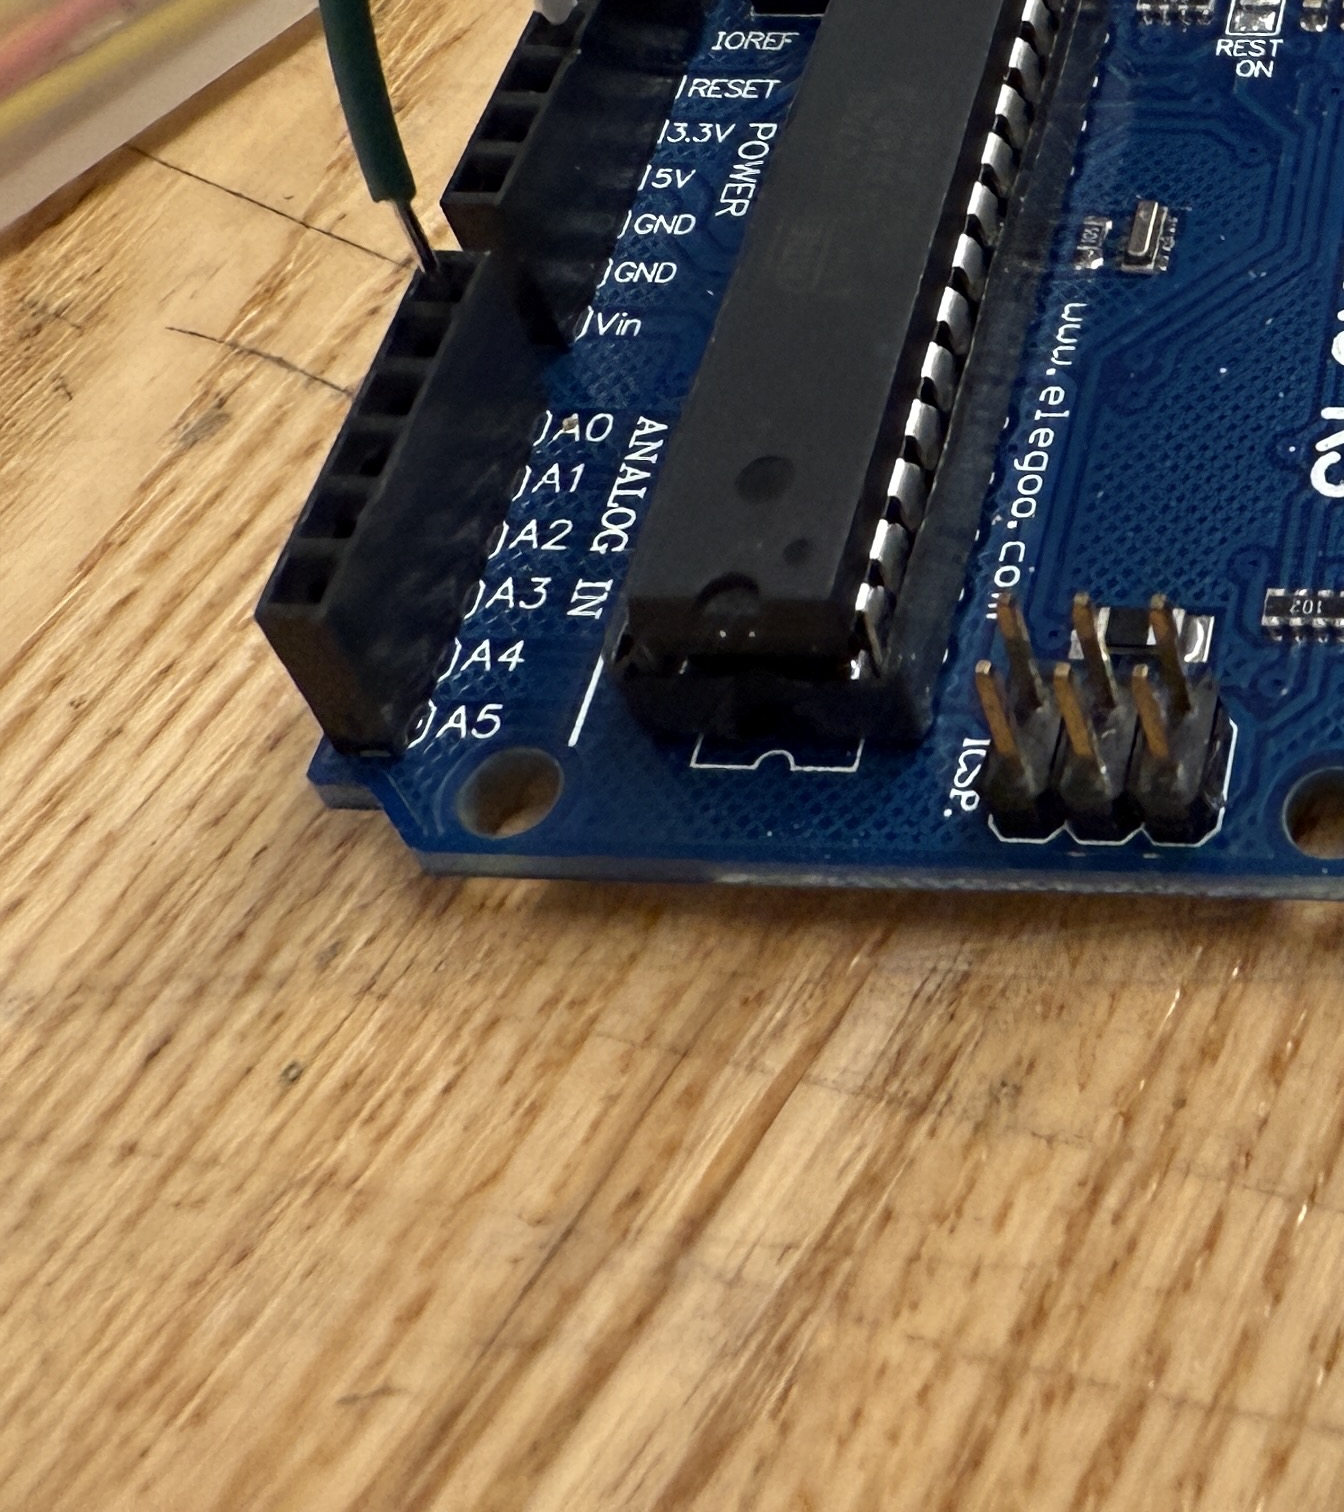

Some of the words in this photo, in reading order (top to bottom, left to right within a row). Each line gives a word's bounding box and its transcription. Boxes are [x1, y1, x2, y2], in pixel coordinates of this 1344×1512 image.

[711, 31, 799, 51] IOREF
[1215, 39, 1284, 57] REST
[1236, 60, 1274, 78] ON
[688, 79, 781, 99] RESET
[667, 122, 736, 143] 3.3V
[651, 168, 696, 189] 5V
[715, 122, 777, 217] POWER
[634, 213, 696, 235] GND
[614, 261, 677, 283] GND
[597, 312, 642, 336] Vin
[548, 413, 614, 442] A0
[532, 463, 585, 493] A1
[590, 416, 668, 554] ANALOG
[509, 519, 573, 551] A2
[486, 576, 552, 609] A3
[566, 578, 614, 620] IN
[461, 639, 525, 672] A4
[436, 704, 503, 740] A5
